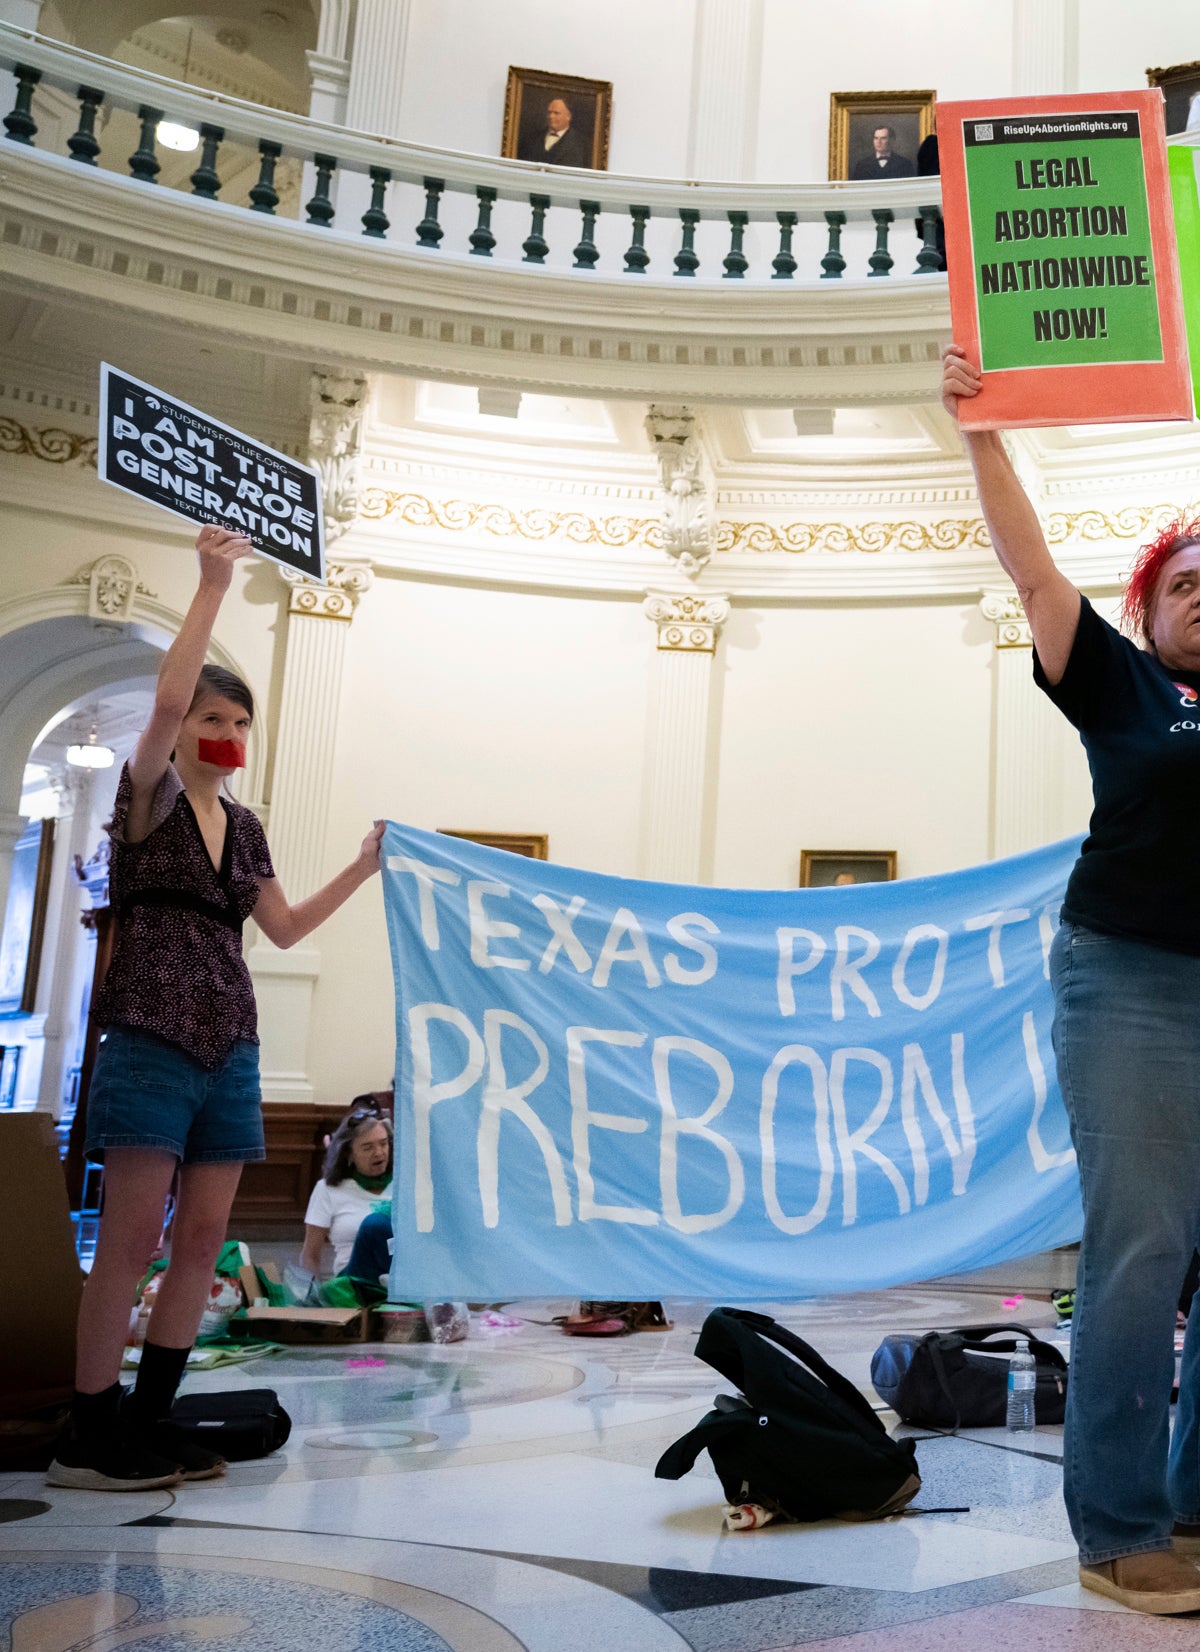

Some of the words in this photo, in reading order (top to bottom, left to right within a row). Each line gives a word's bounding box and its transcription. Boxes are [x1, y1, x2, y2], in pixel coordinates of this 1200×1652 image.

[1004, 121, 1128, 136] RiseUp4AbortionRights.org
[1015, 157, 1098, 191] LEGAL
[995, 206, 1128, 243] ABORTION
[981, 255, 1151, 295] NATIONWIDE
[1033, 307, 1108, 343] NOW!
[125, 397, 134, 417] I
[154, 417, 215, 458] AM
[233, 453, 302, 501] THE
[161, 404, 288, 474] STUDENTSFORLIFE.ORG
[113, 415, 315, 532] POST-ROE
[116, 450, 312, 557] GENERATION
[174, 498, 196, 514] TEXT
[199, 510, 218, 525] LIFE
[220, 520, 233, 530] TO
[386, 856, 720, 989] TEXAS
[407, 1002, 975, 1235] PREBORN
[1022, 1011, 1077, 1173] L
